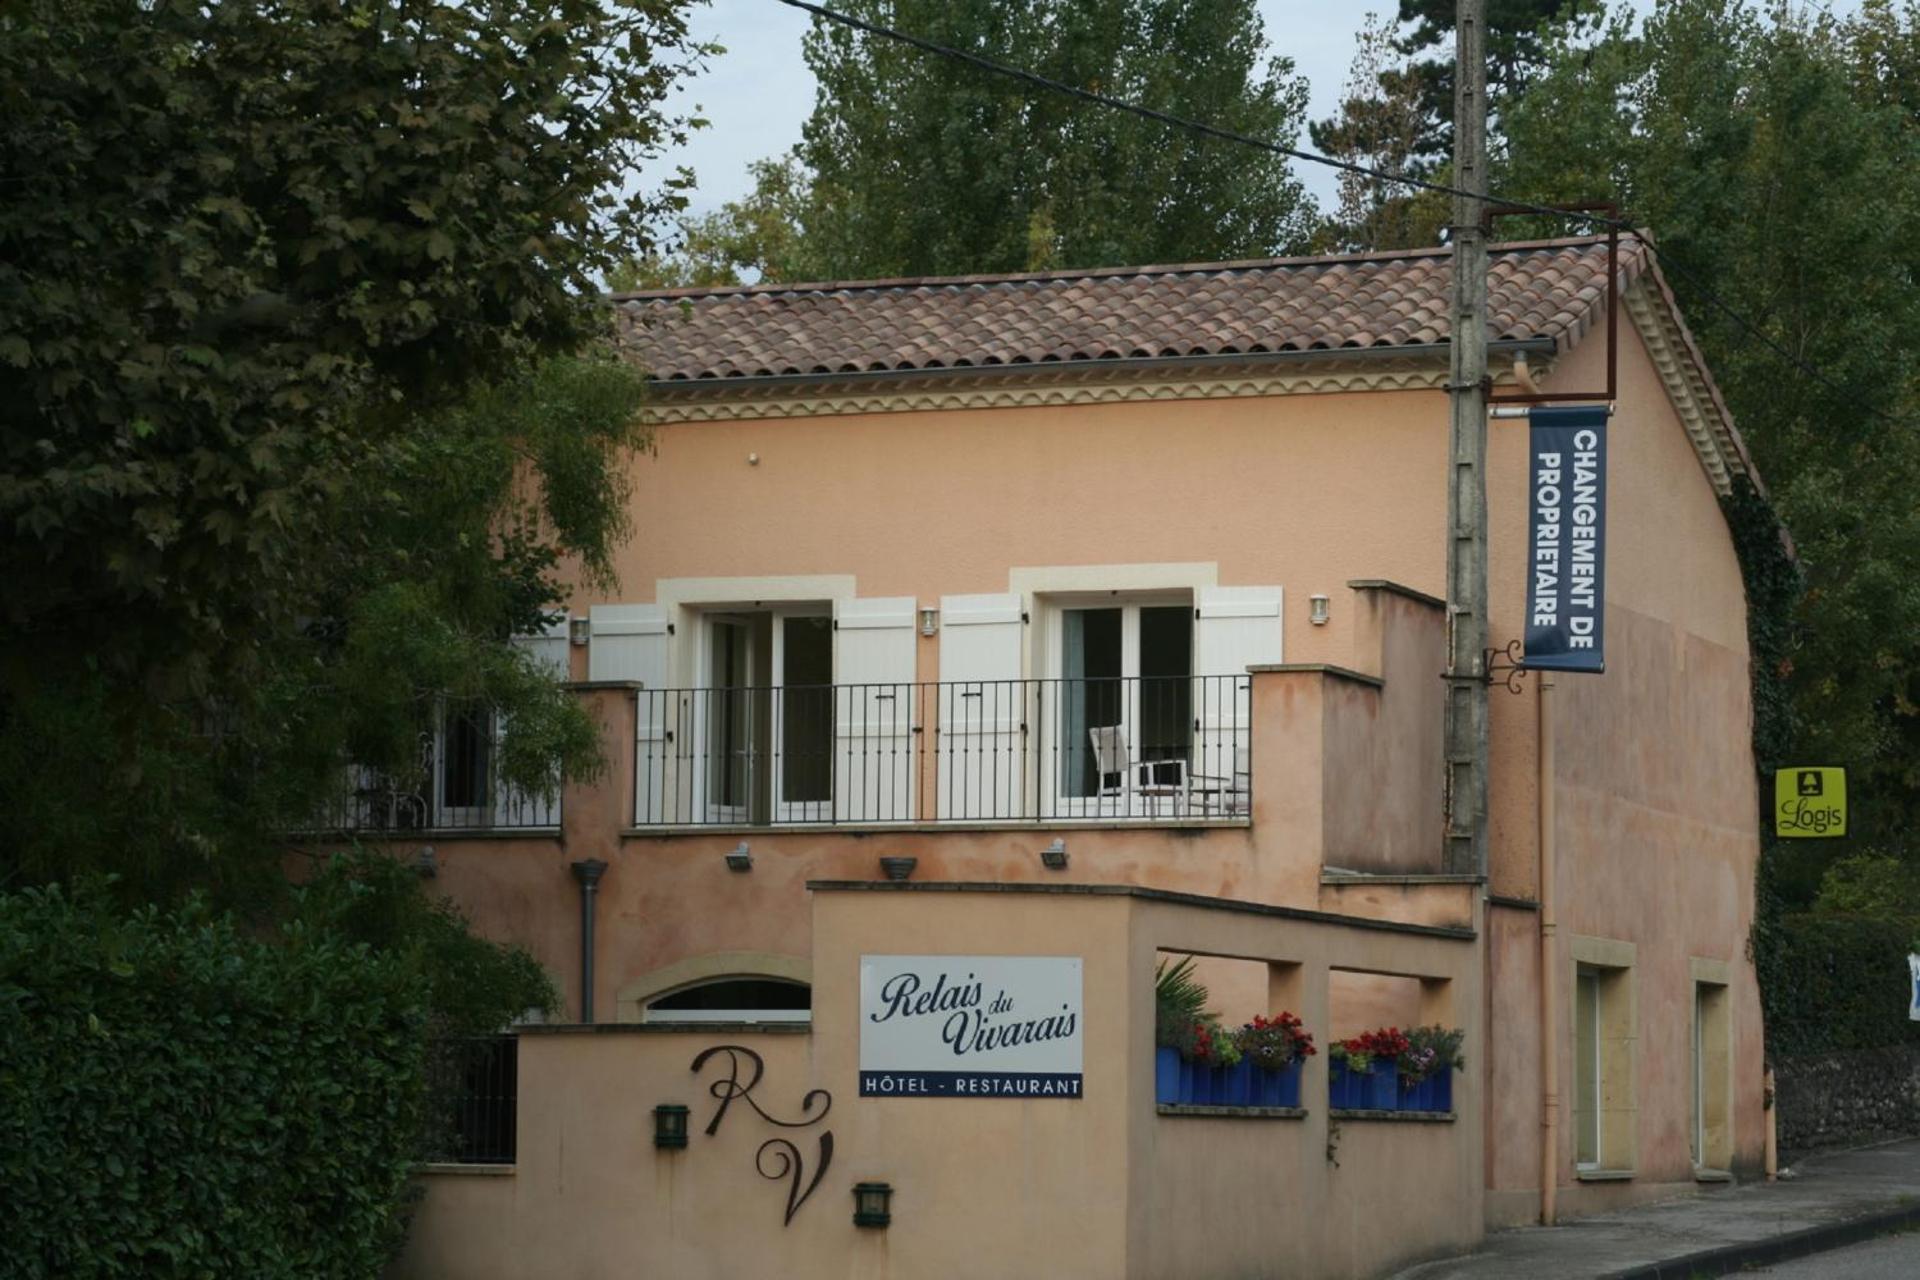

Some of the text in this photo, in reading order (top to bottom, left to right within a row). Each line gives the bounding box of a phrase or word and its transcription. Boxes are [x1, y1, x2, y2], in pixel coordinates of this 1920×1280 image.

[1533, 452, 1561, 626] PROPRIETAIRE
[1569, 429, 1597, 649] CHANGEMENT DE
[1779, 797, 1842, 833] Logis
[870, 972, 1014, 1023] Relais du
[942, 1003, 1076, 1056] Vivarais
[865, 1075, 928, 1092] HÔTEL
[956, 1078, 1080, 1094] RESTAURANT
